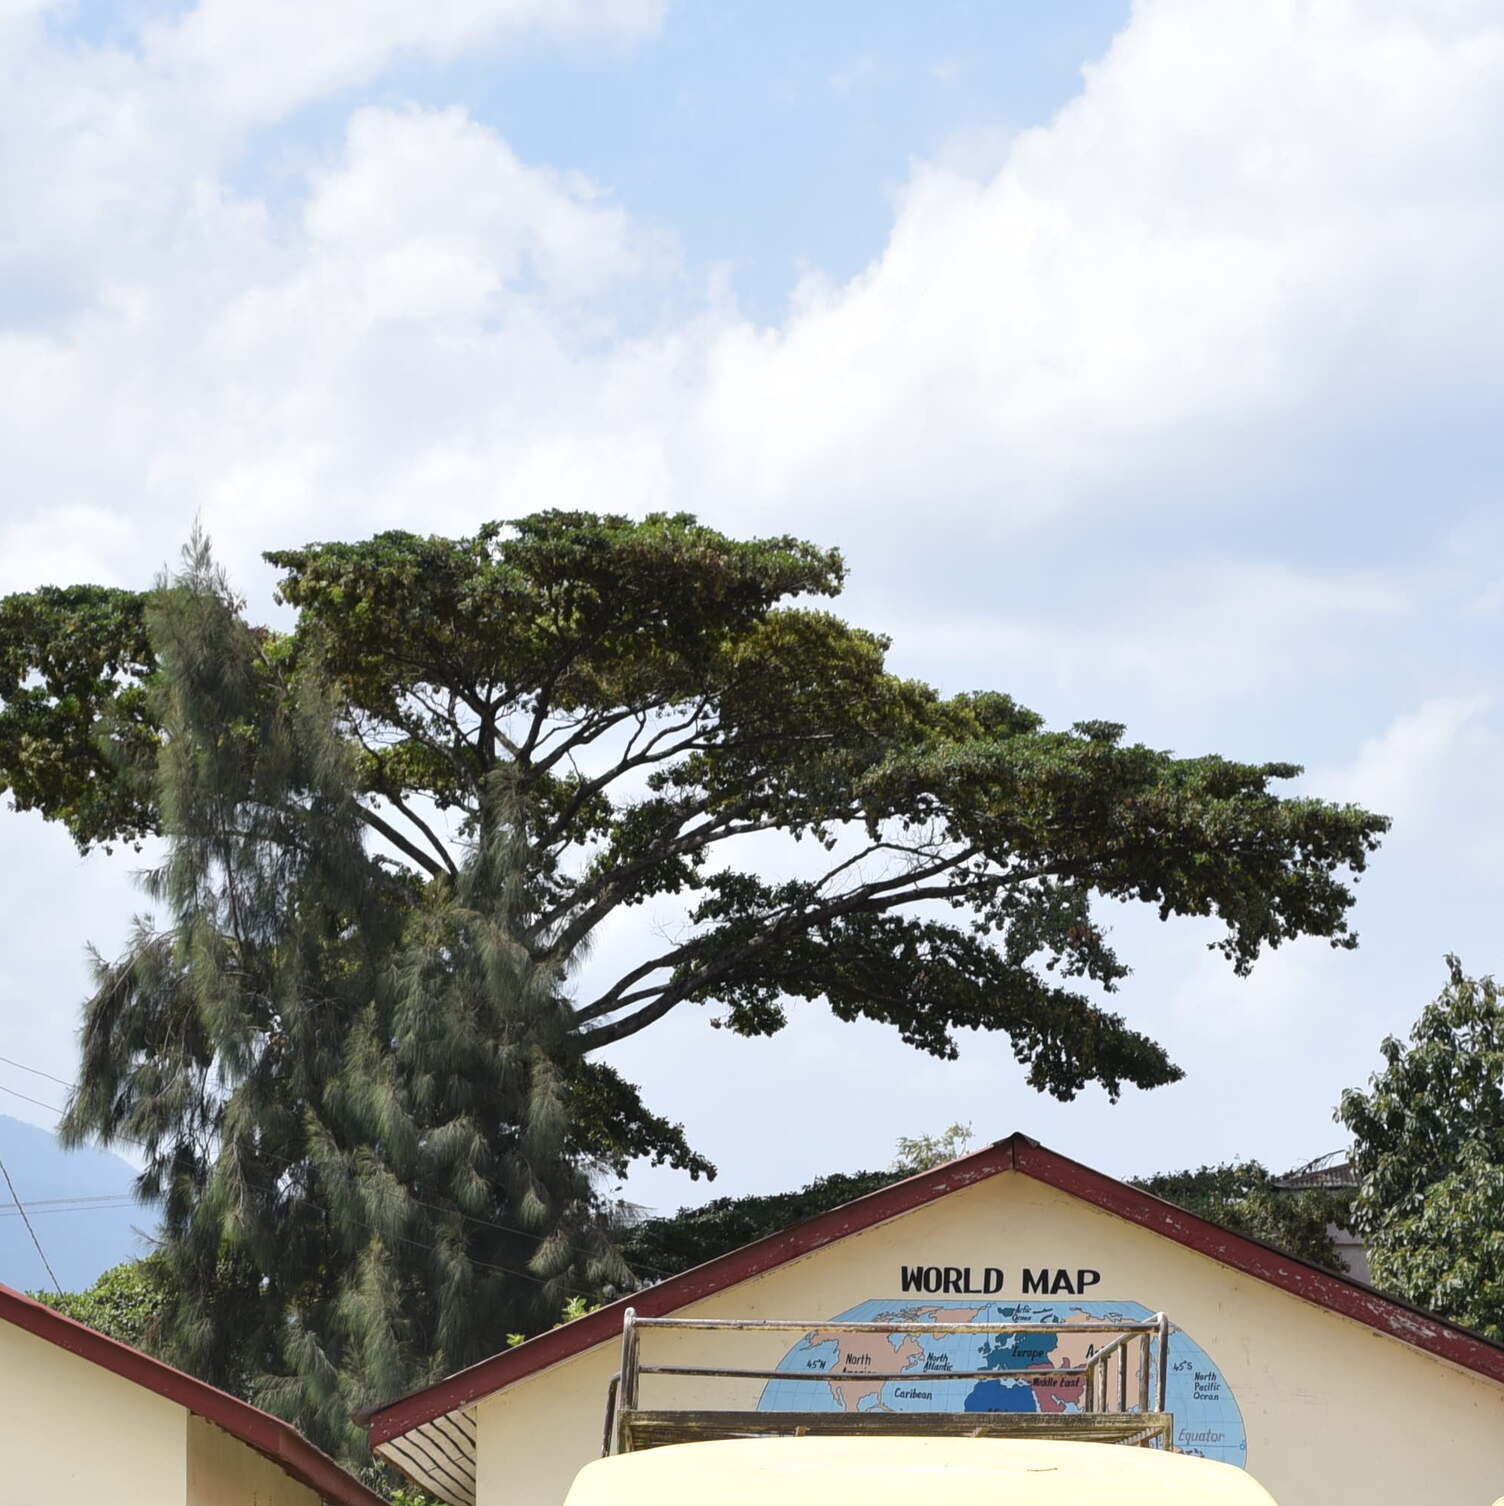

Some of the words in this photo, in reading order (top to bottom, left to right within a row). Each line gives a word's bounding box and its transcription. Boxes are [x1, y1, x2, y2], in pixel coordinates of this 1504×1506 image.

[901, 1266, 1004, 1294] WORLD
[1022, 1268, 1101, 1295] MAP
[926, 1352, 949, 1363] North
[1011, 1345, 1044, 1361] Europe
[846, 1353, 872, 1366] North
[923, 1361, 953, 1373] Atlantic
[1032, 1377, 1057, 1387] Middle
[1059, 1377, 1080, 1388] East
[1194, 1372, 1217, 1381] North
[1194, 1381, 1221, 1391] Pacific
[894, 1388, 932, 1400] Caribean
[1193, 1391, 1220, 1401] Ocean
[1178, 1428, 1225, 1446] Equator
